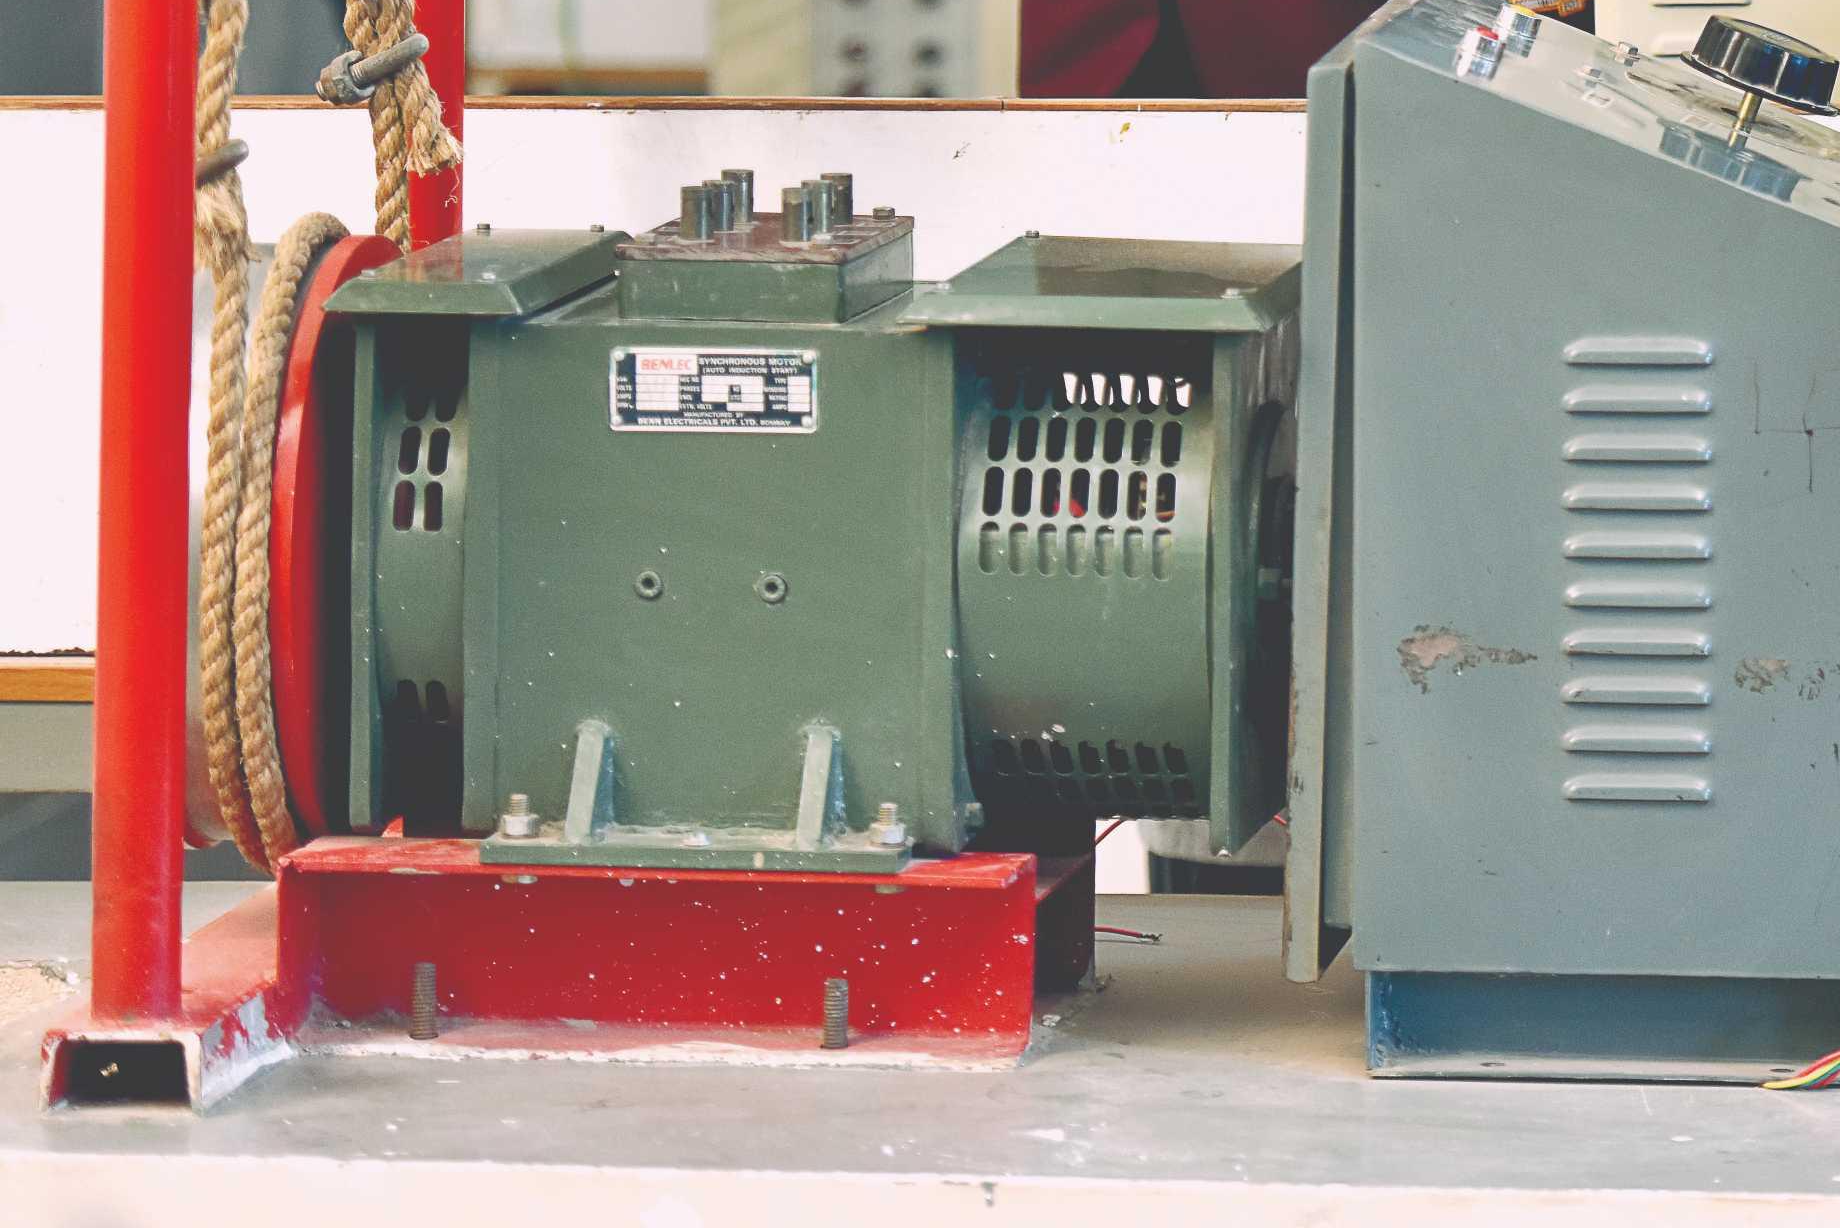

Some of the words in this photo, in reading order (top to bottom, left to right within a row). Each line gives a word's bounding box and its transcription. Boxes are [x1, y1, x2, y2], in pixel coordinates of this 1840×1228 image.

[640, 358, 692, 371] BENLEC
[699, 357, 766, 367] SYNCHRONOUS
[768, 358, 802, 367] MOTOR
[728, 367, 768, 375] INDUCTION
[663, 418, 719, 428] ELECTRICALS
